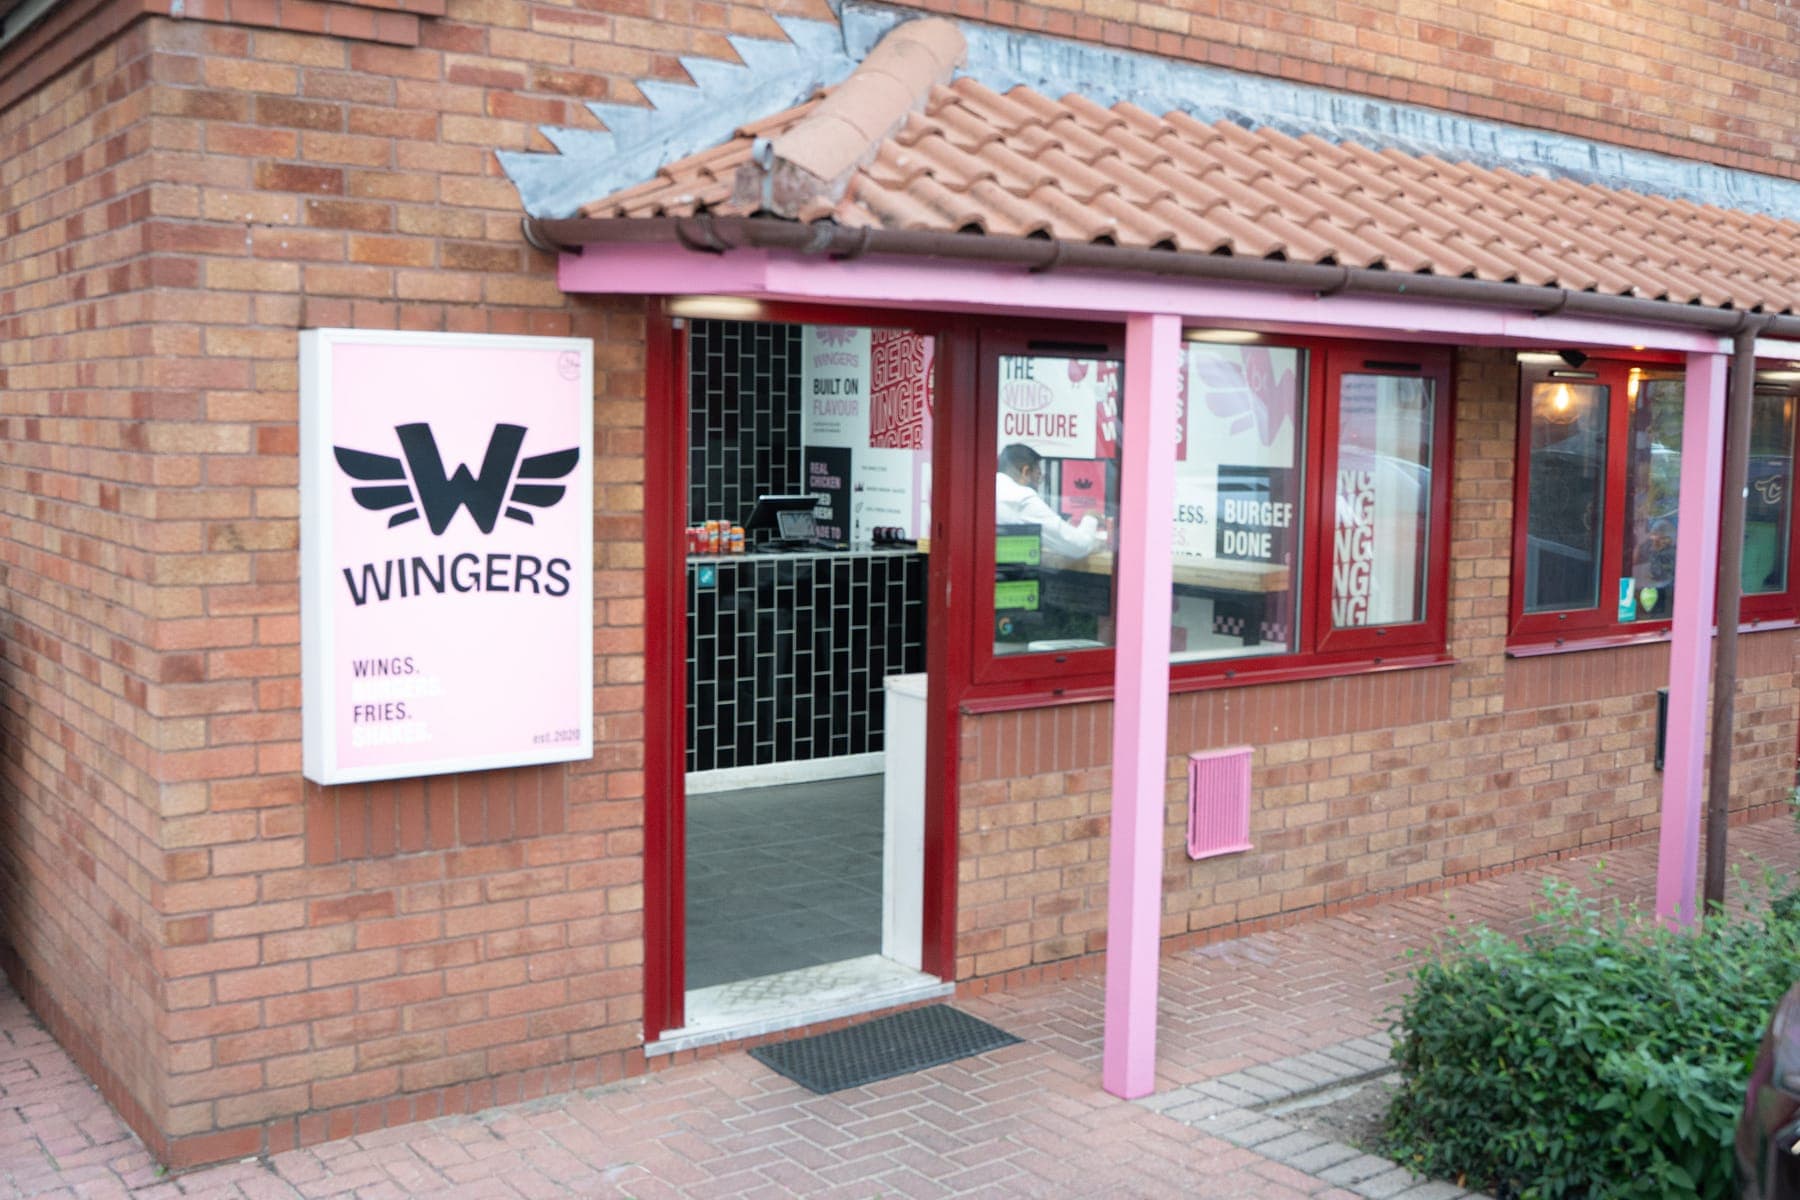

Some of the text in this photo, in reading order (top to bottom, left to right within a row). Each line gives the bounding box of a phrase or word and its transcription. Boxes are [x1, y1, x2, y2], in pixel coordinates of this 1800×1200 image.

[1004, 356, 1034, 380] THE
[813, 378, 859, 395] BUILT ON
[1004, 383, 1049, 409] WING
[813, 399, 859, 416] FLAVOUR
[1004, 412, 1078, 437] CULTURE
[810, 462, 829, 475] REAL
[810, 475, 841, 490] CHICKEN
[1223, 530, 1273, 559] DONE
[342, 552, 572, 607] WINGERS
[352, 656, 421, 678] WINGS.
[353, 702, 413, 724] FRIES.
